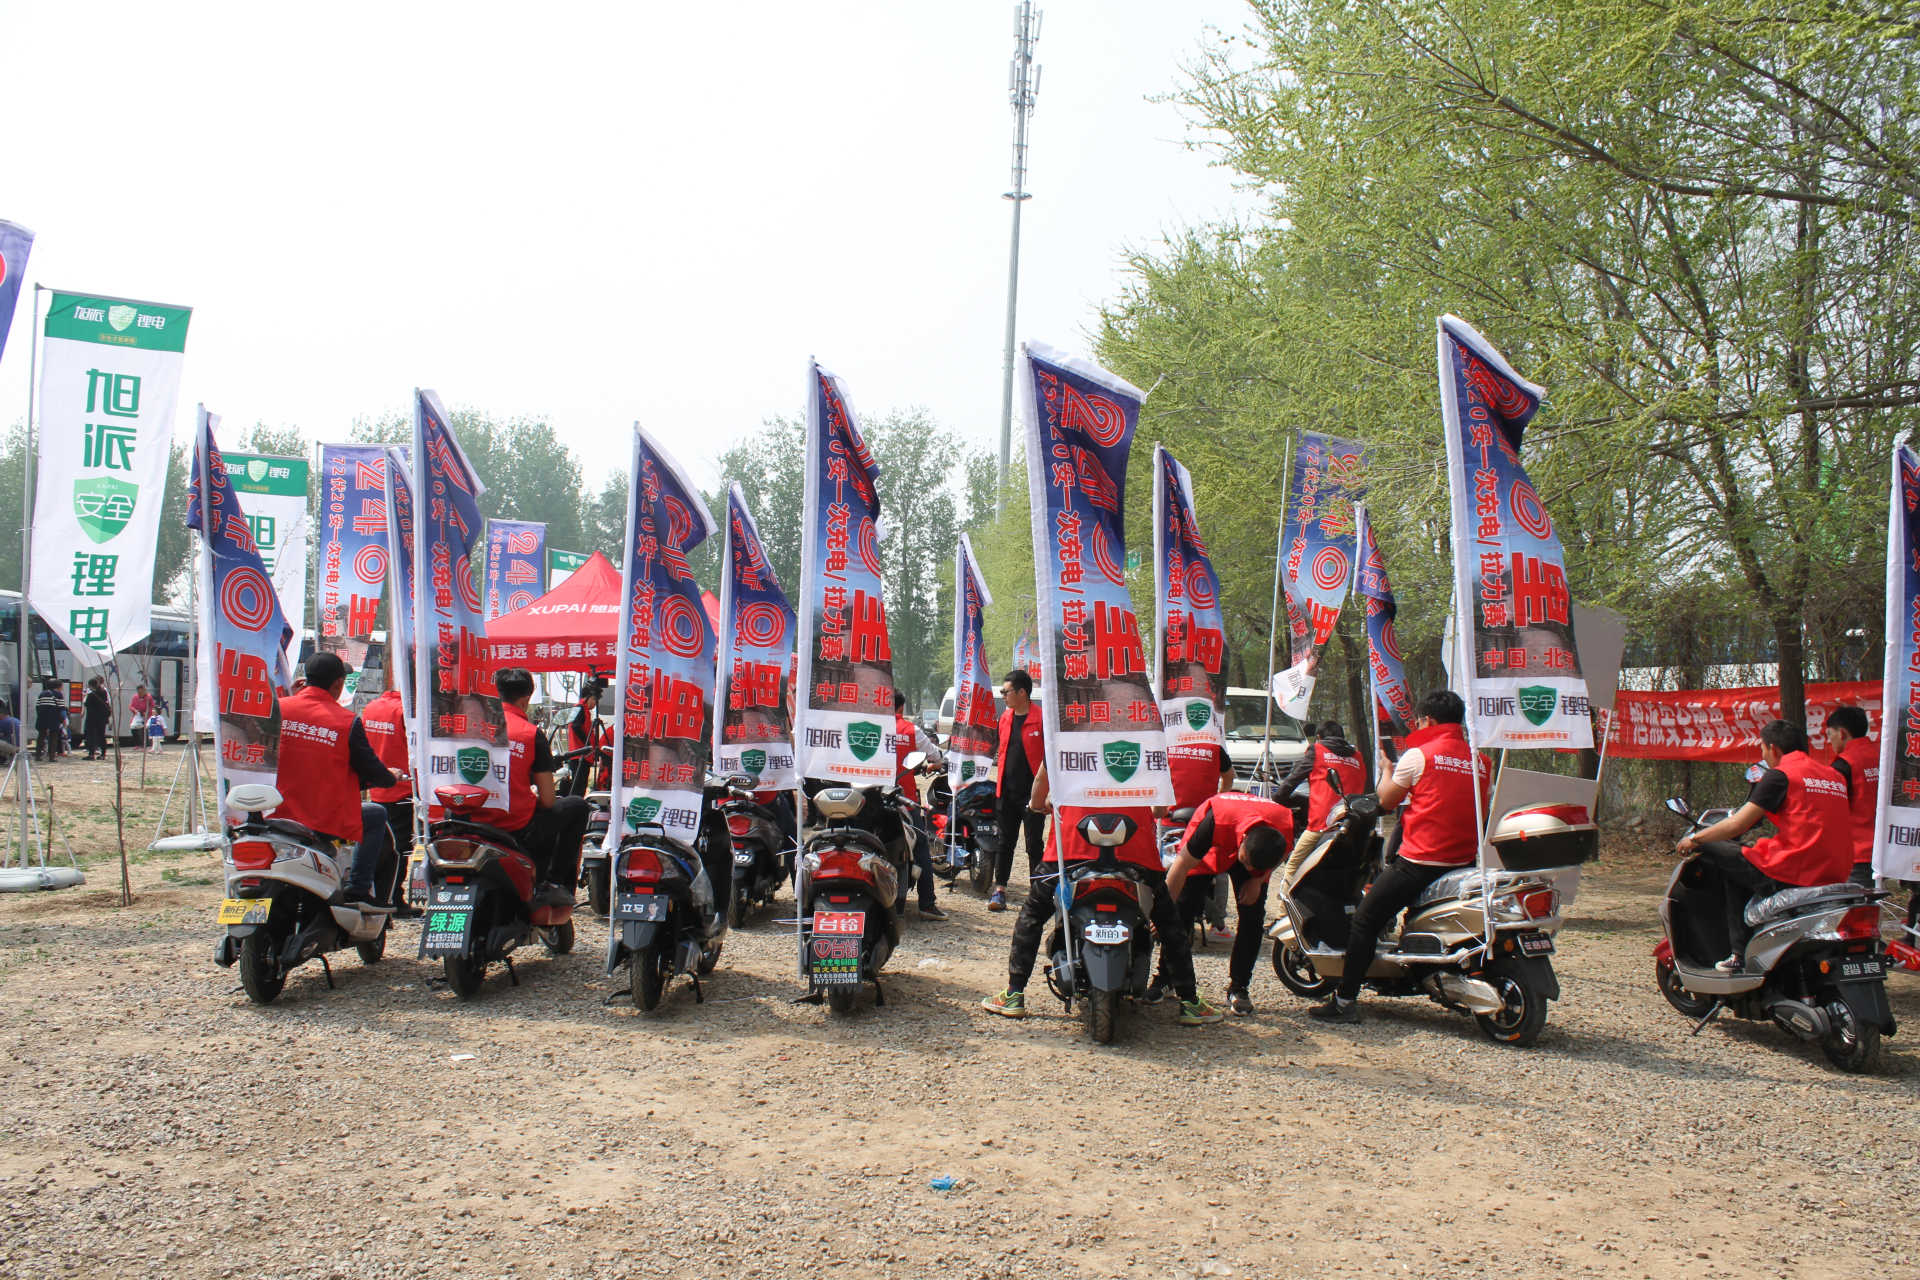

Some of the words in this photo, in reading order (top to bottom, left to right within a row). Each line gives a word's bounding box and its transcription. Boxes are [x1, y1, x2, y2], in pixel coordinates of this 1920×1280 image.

[75, 492, 133, 518] 安全
[527, 604, 587, 616] XUPAI
[535, 642, 600, 659] 寿命更长
[1188, 709, 1210, 721] 安全
[1479, 696, 1515, 716] 旭派
[1521, 694, 1554, 711] 安全
[806, 727, 842, 749] 旭派
[849, 731, 880, 748] 安全
[222, 739, 267, 763] 北京
[1060, 751, 1098, 771] 旭派
[1105, 750, 1138, 768] 安全
[743, 756, 765, 768] 安全
[769, 755, 793, 769] 锂电
[662, 806, 698, 830] 锂电
[429, 912, 468, 932] 绿源
[819, 918, 858, 932] 台铃
[831, 938, 859, 959] 台铃
